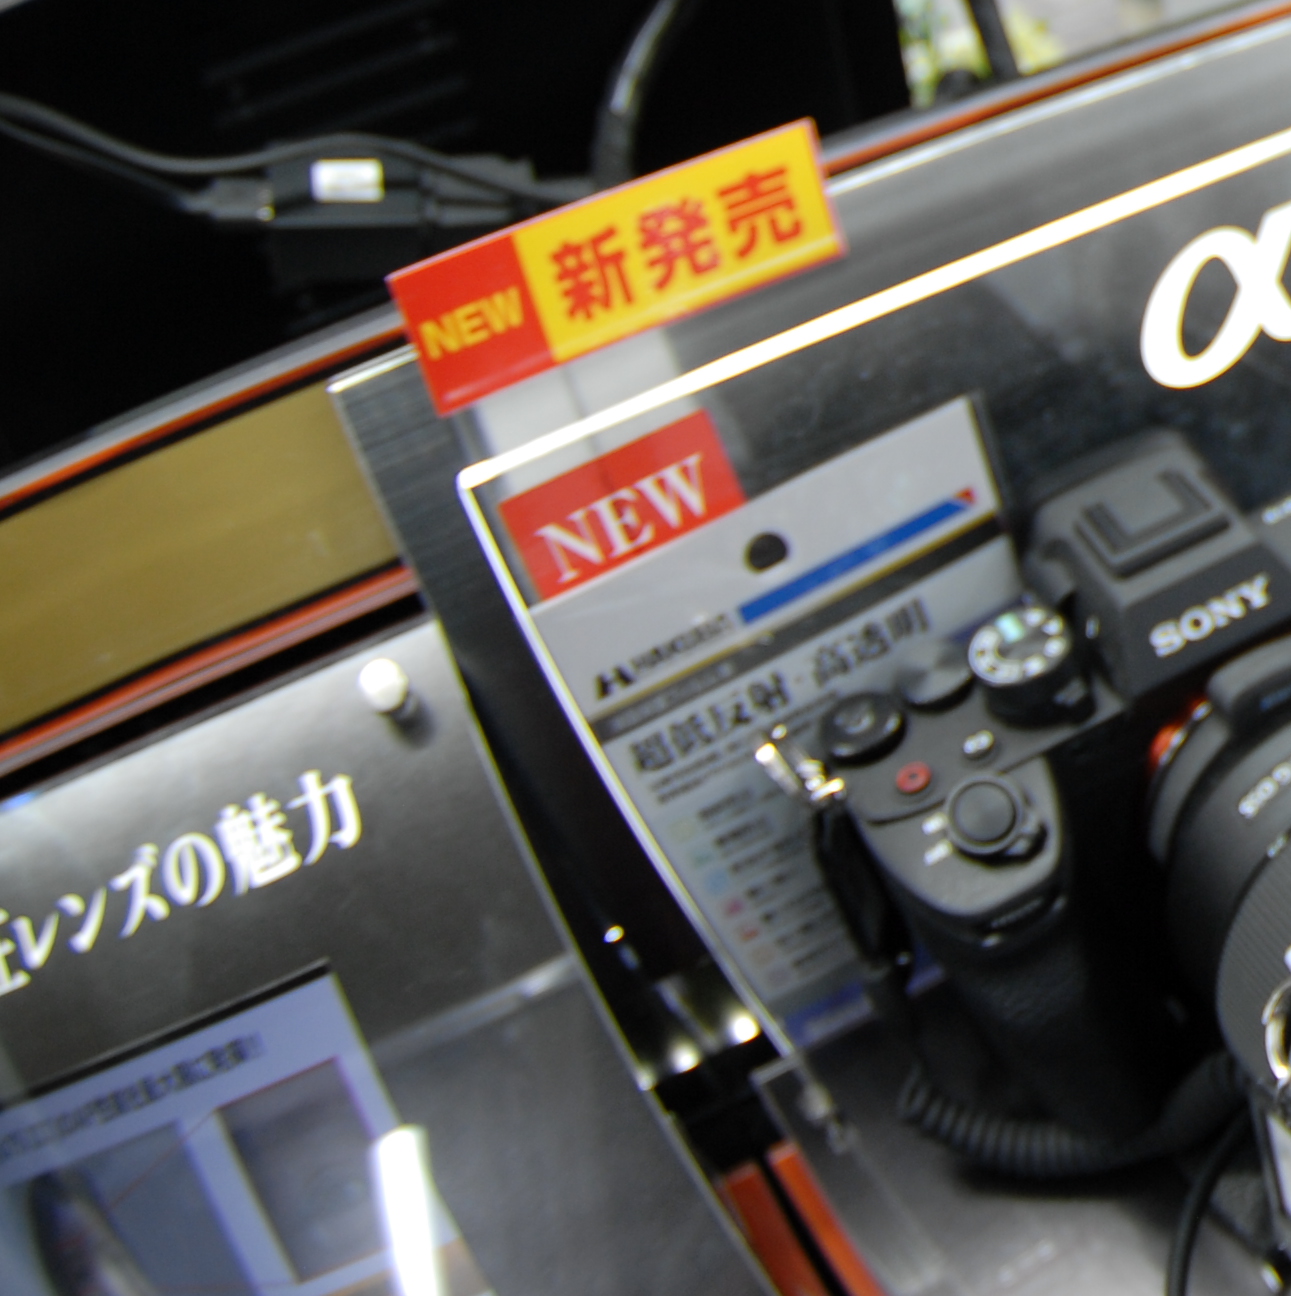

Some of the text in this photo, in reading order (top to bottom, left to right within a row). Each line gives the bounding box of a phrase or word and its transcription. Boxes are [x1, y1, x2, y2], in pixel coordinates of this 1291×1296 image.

[549, 164, 806, 323] 新発売
[418, 284, 526, 362] NEW
[534, 450, 712, 585] NEW
[1148, 571, 1271, 658] SONY
